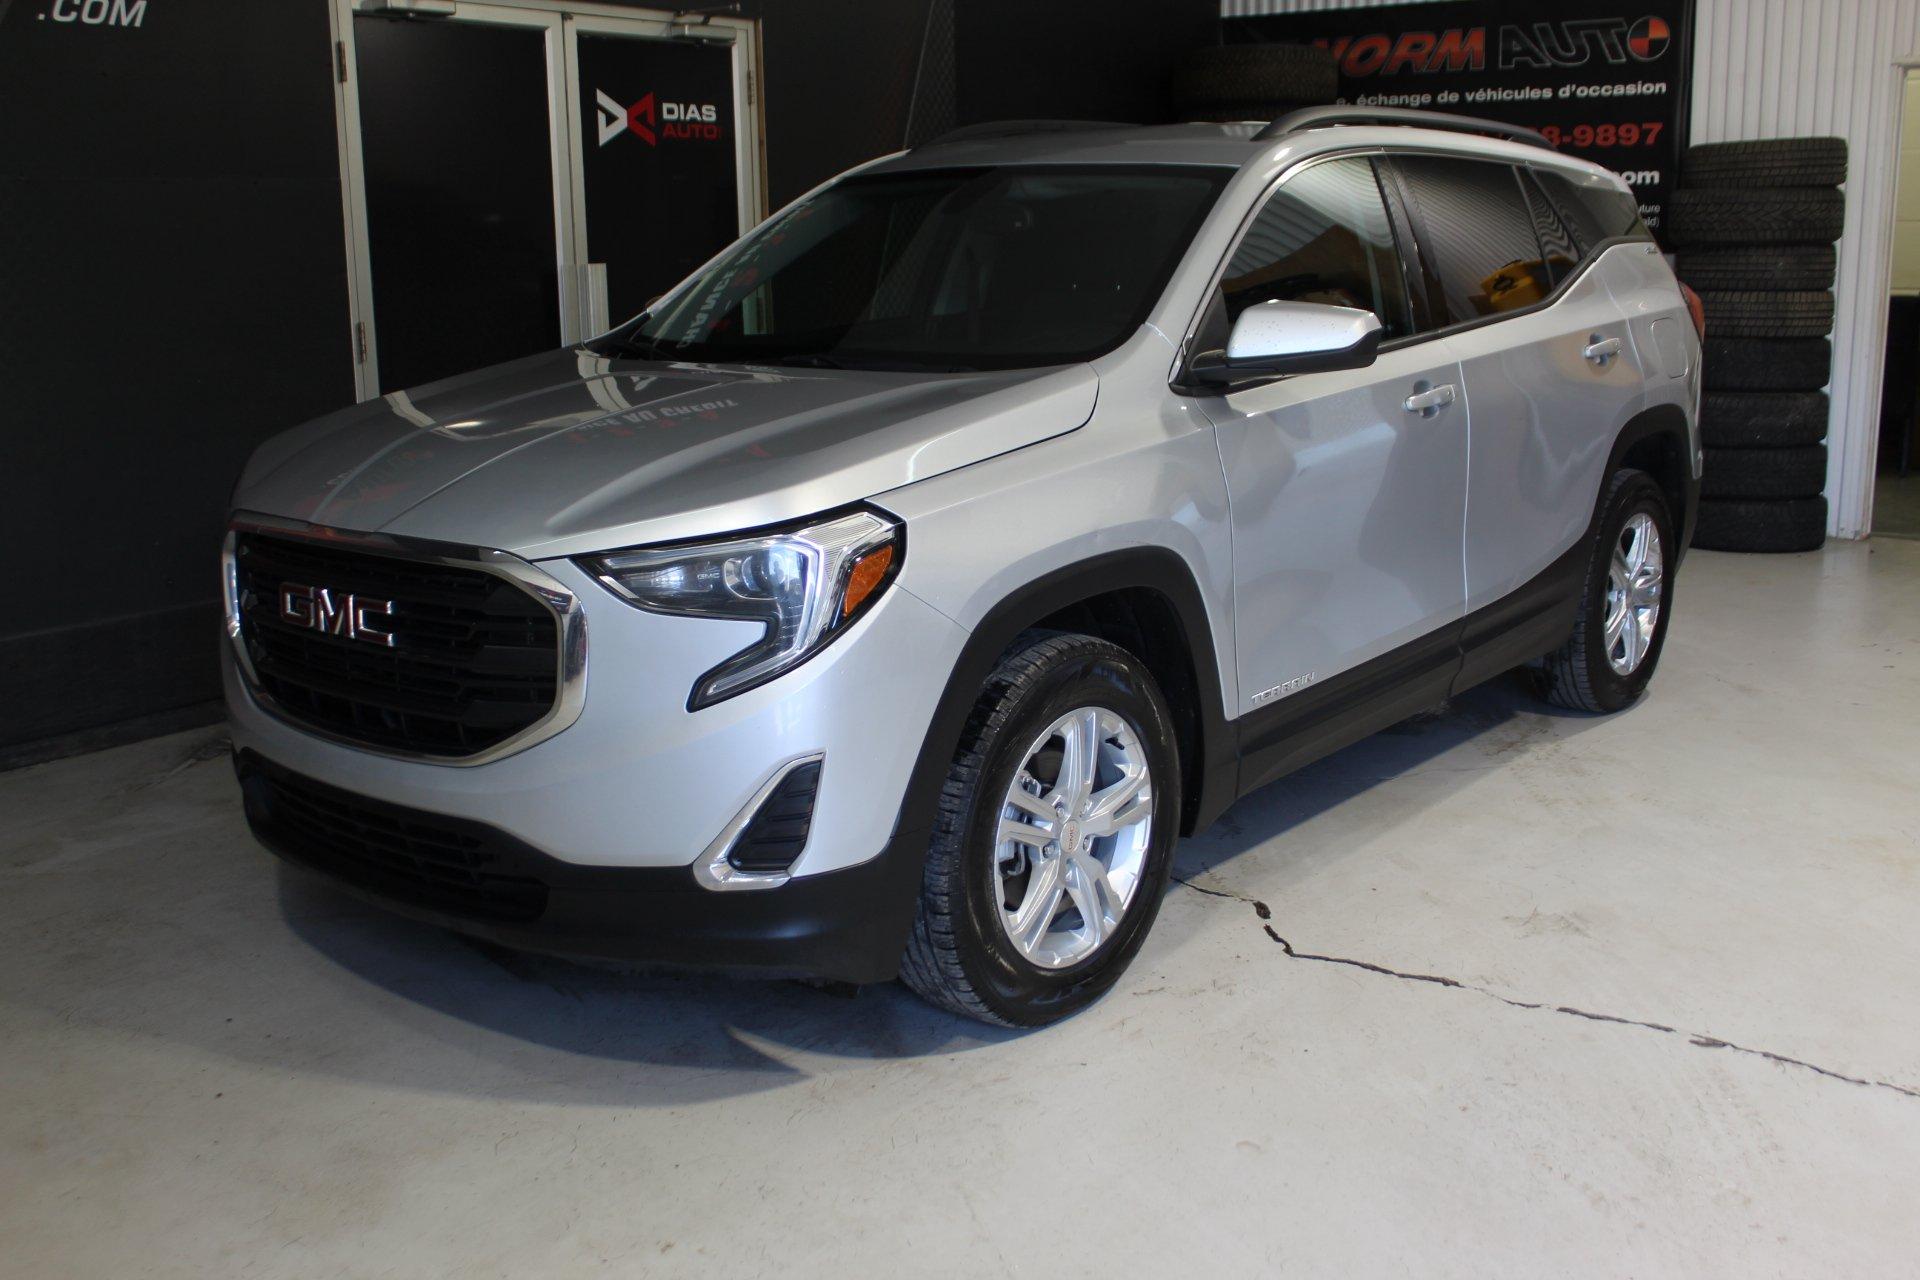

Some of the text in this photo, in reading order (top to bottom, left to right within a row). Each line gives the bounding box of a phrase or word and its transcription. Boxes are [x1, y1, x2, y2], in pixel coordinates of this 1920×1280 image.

[37, 0, 147, 28] .COM
[1356, 92, 1432, 107] échange
[1437, 90, 1460, 103] de
[1465, 86, 1553, 101] véhicules
[1558, 80, 1667, 99] d'occasion
[661, 101, 717, 122] DIAS
[279, 581, 395, 648] GMC
[1249, 671, 1318, 705] TERRAIN
